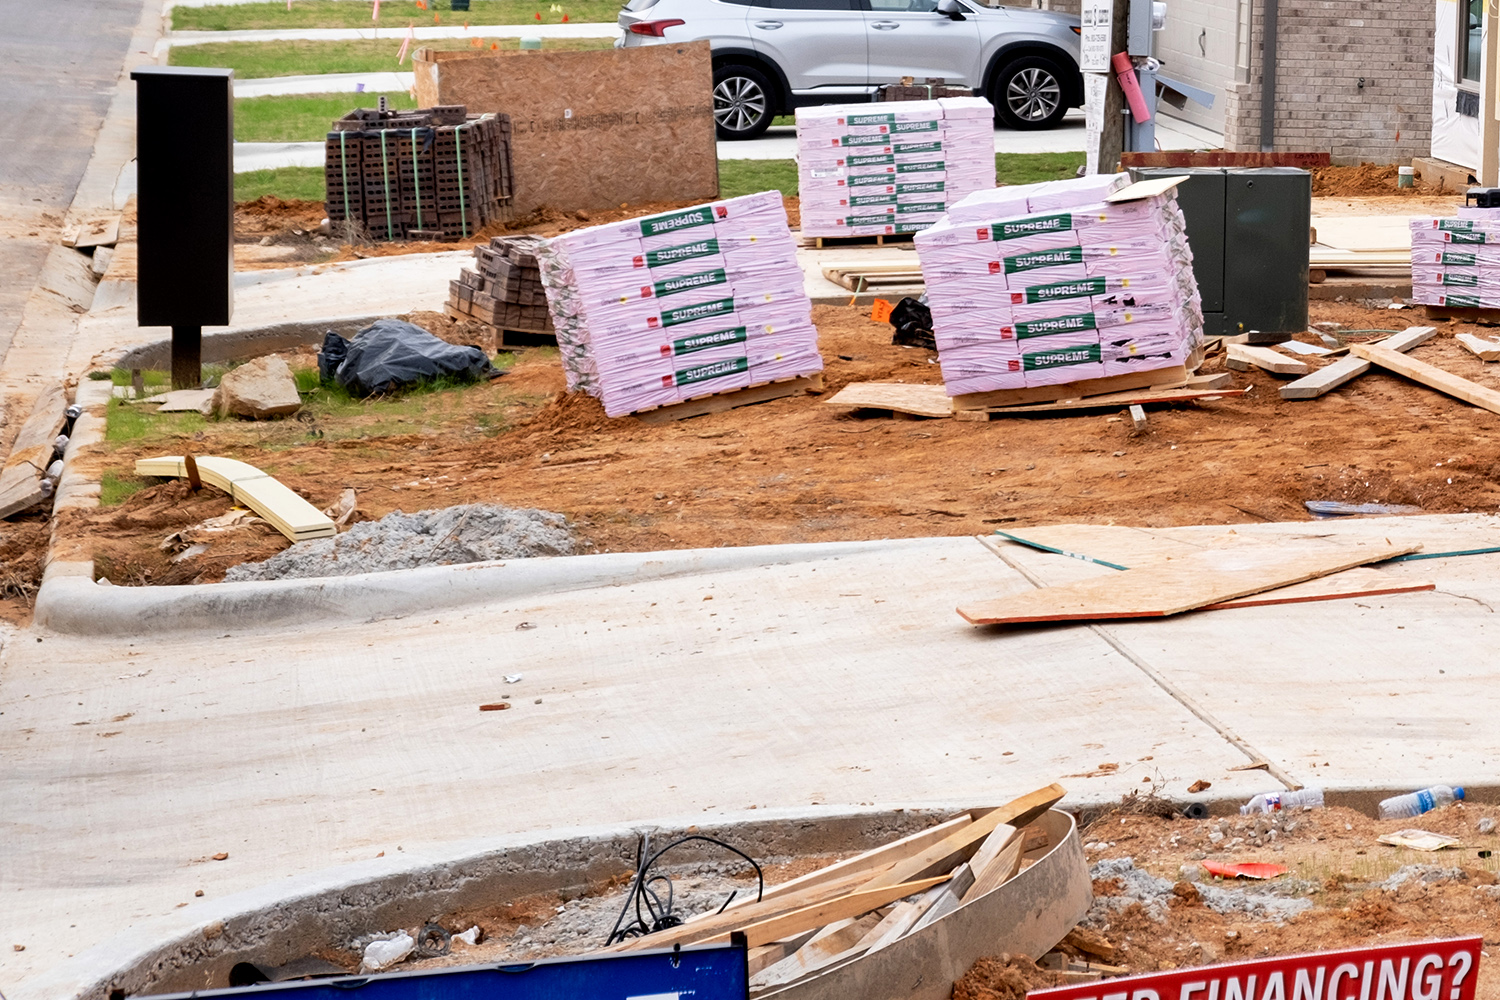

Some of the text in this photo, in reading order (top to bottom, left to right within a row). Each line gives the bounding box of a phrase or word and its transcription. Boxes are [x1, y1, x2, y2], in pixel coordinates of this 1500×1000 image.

[854, 115, 888, 124] SUPREME
[896, 122, 931, 131] SUPREME
[848, 135, 883, 144] SUPREME
[853, 156, 888, 164] SUPREME
[651, 212, 704, 232] SUPREME
[1004, 218, 1060, 234] SUPREME
[657, 243, 709, 260] SUPREME
[1016, 251, 1072, 267] SUPREME
[664, 272, 717, 291] SUPREME
[1038, 282, 1094, 298] SUPREME
[672, 302, 724, 320] SUPREME
[1027, 317, 1084, 333] SUPREME
[684, 330, 736, 348] SUPREME
[1035, 350, 1090, 366] SUPREME
[686, 361, 738, 380] SUPREME
